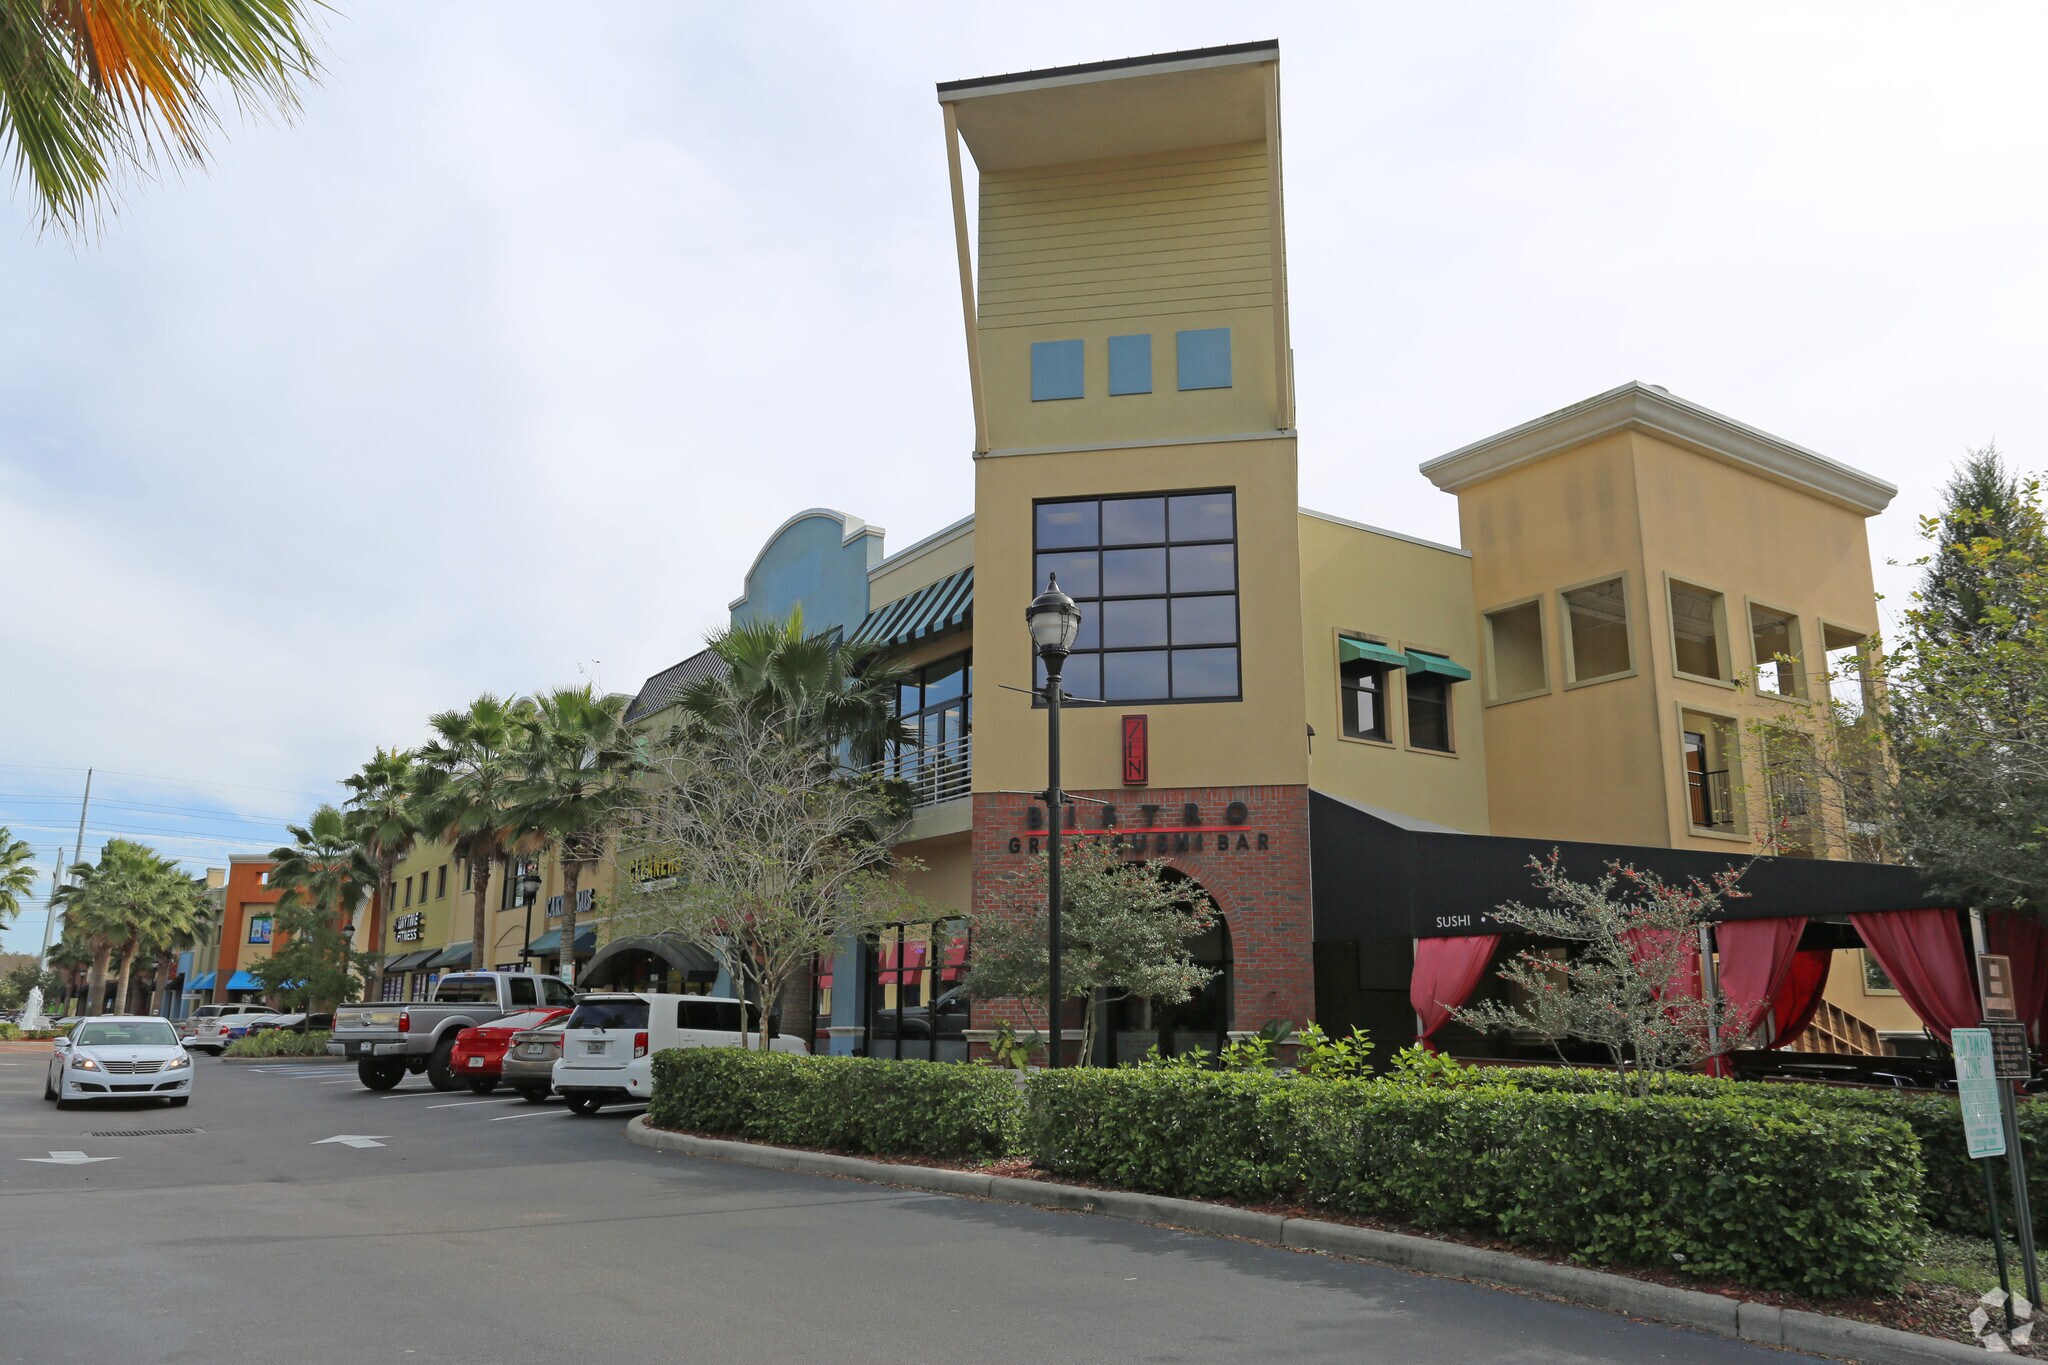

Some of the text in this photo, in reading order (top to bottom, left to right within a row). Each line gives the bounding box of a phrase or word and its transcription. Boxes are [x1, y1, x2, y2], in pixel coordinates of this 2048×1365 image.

[1126, 720, 1142, 778] ZEN
[1027, 801, 1249, 828] BISTRO
[1111, 832, 1203, 854] SUSHI
[1217, 832, 1270, 852] BAR
[1436, 914, 1471, 928] SUSHI
